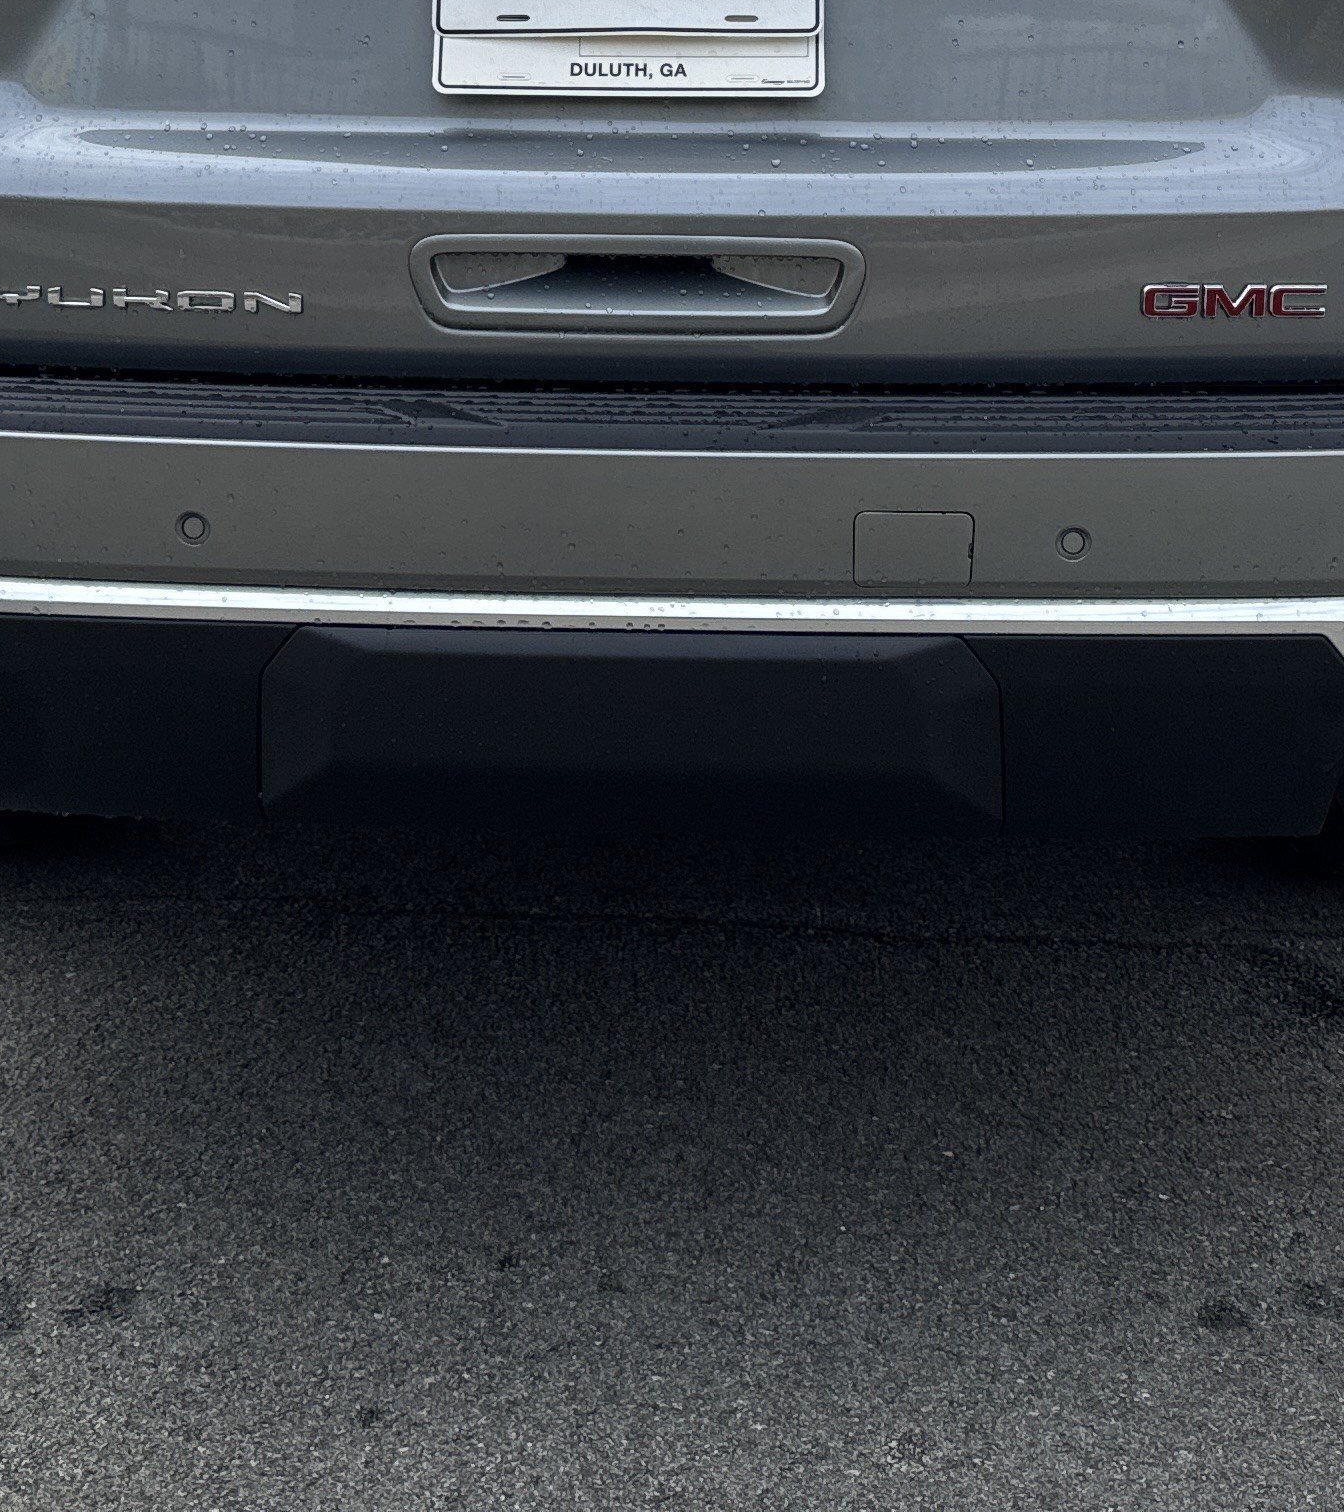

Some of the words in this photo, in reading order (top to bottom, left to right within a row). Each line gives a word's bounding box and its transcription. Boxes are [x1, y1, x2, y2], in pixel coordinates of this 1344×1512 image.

[569, 62, 654, 80] DULUTH,
[659, 62, 688, 78] GA
[1141, 283, 1328, 318] GMC
